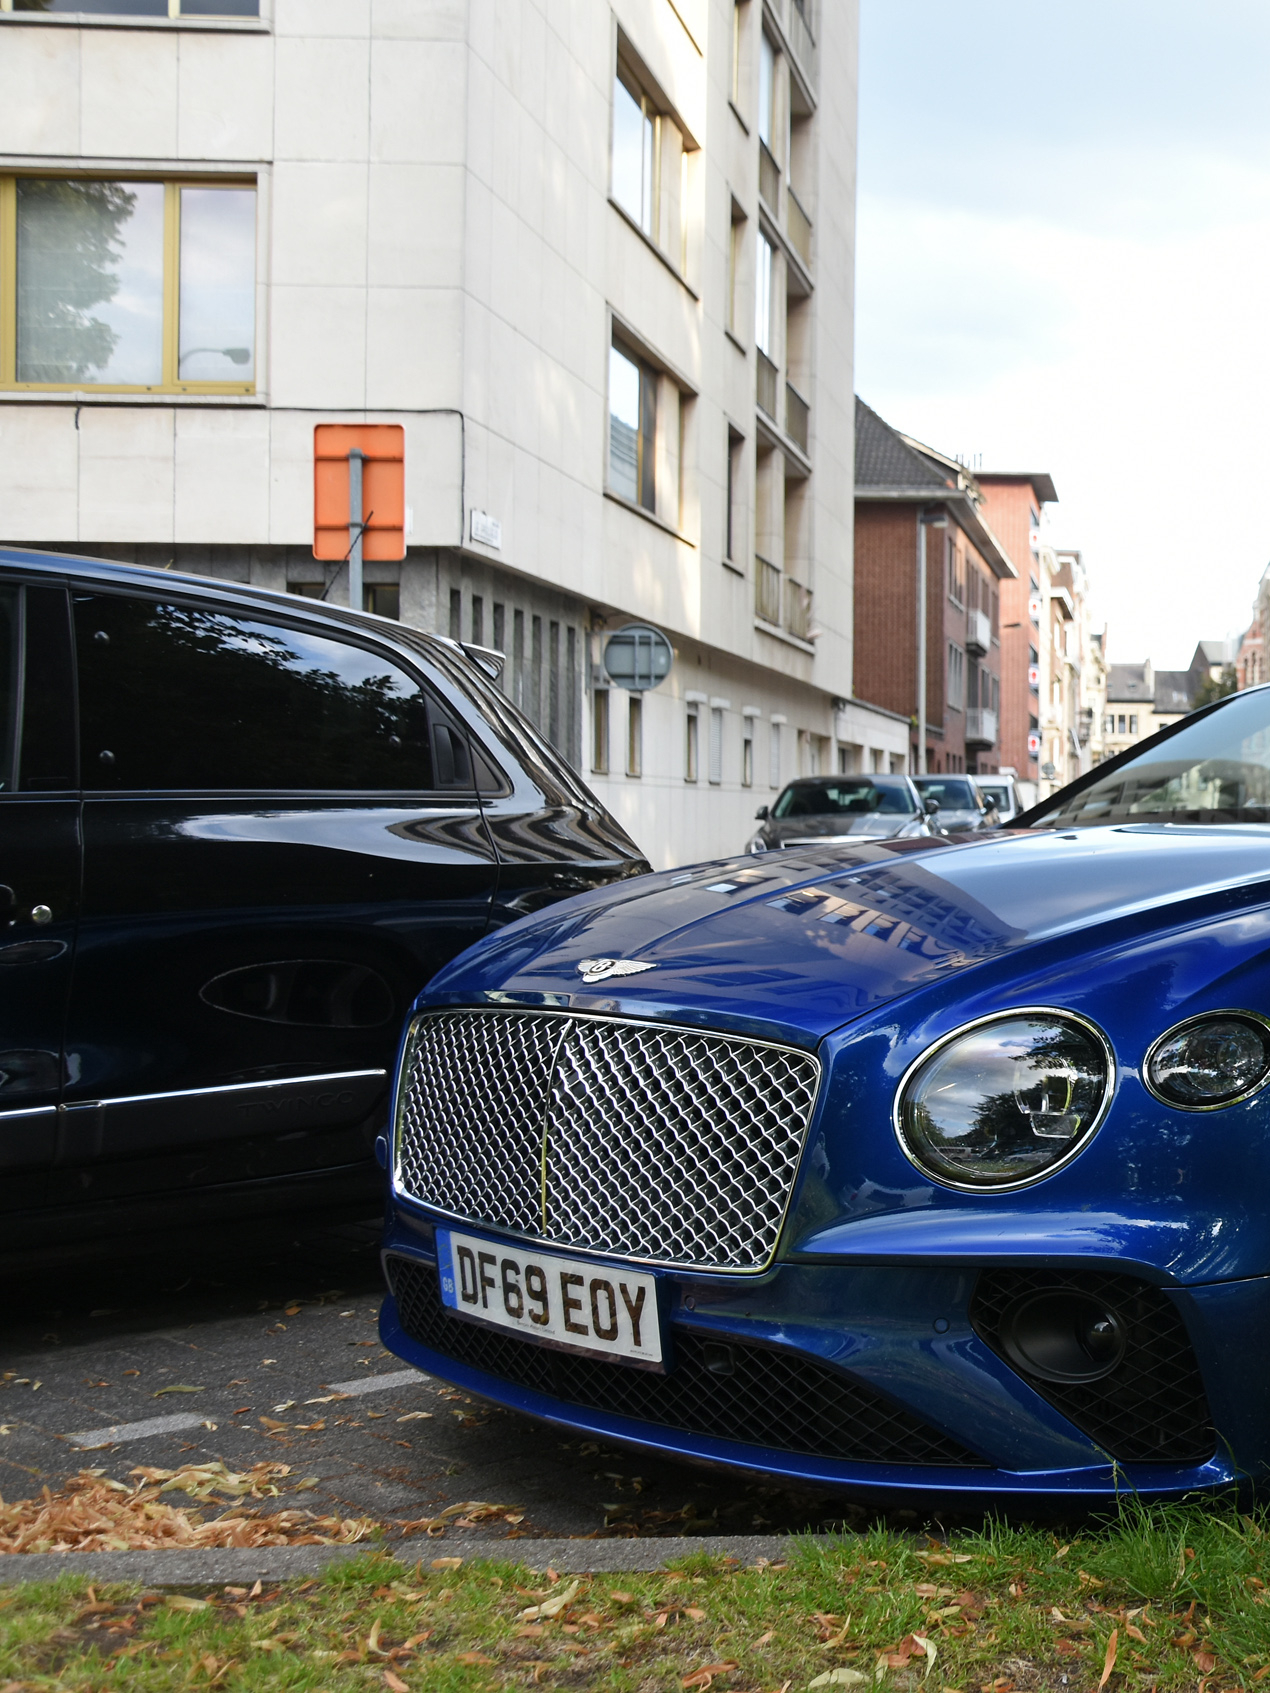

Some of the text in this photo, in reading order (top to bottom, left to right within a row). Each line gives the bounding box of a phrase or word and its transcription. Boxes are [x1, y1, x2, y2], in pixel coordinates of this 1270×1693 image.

[237, 1090, 356, 1116] TWINGO
[442, 1276, 454, 1294] GB
[456, 1244, 647, 1348] DF69 EOY
